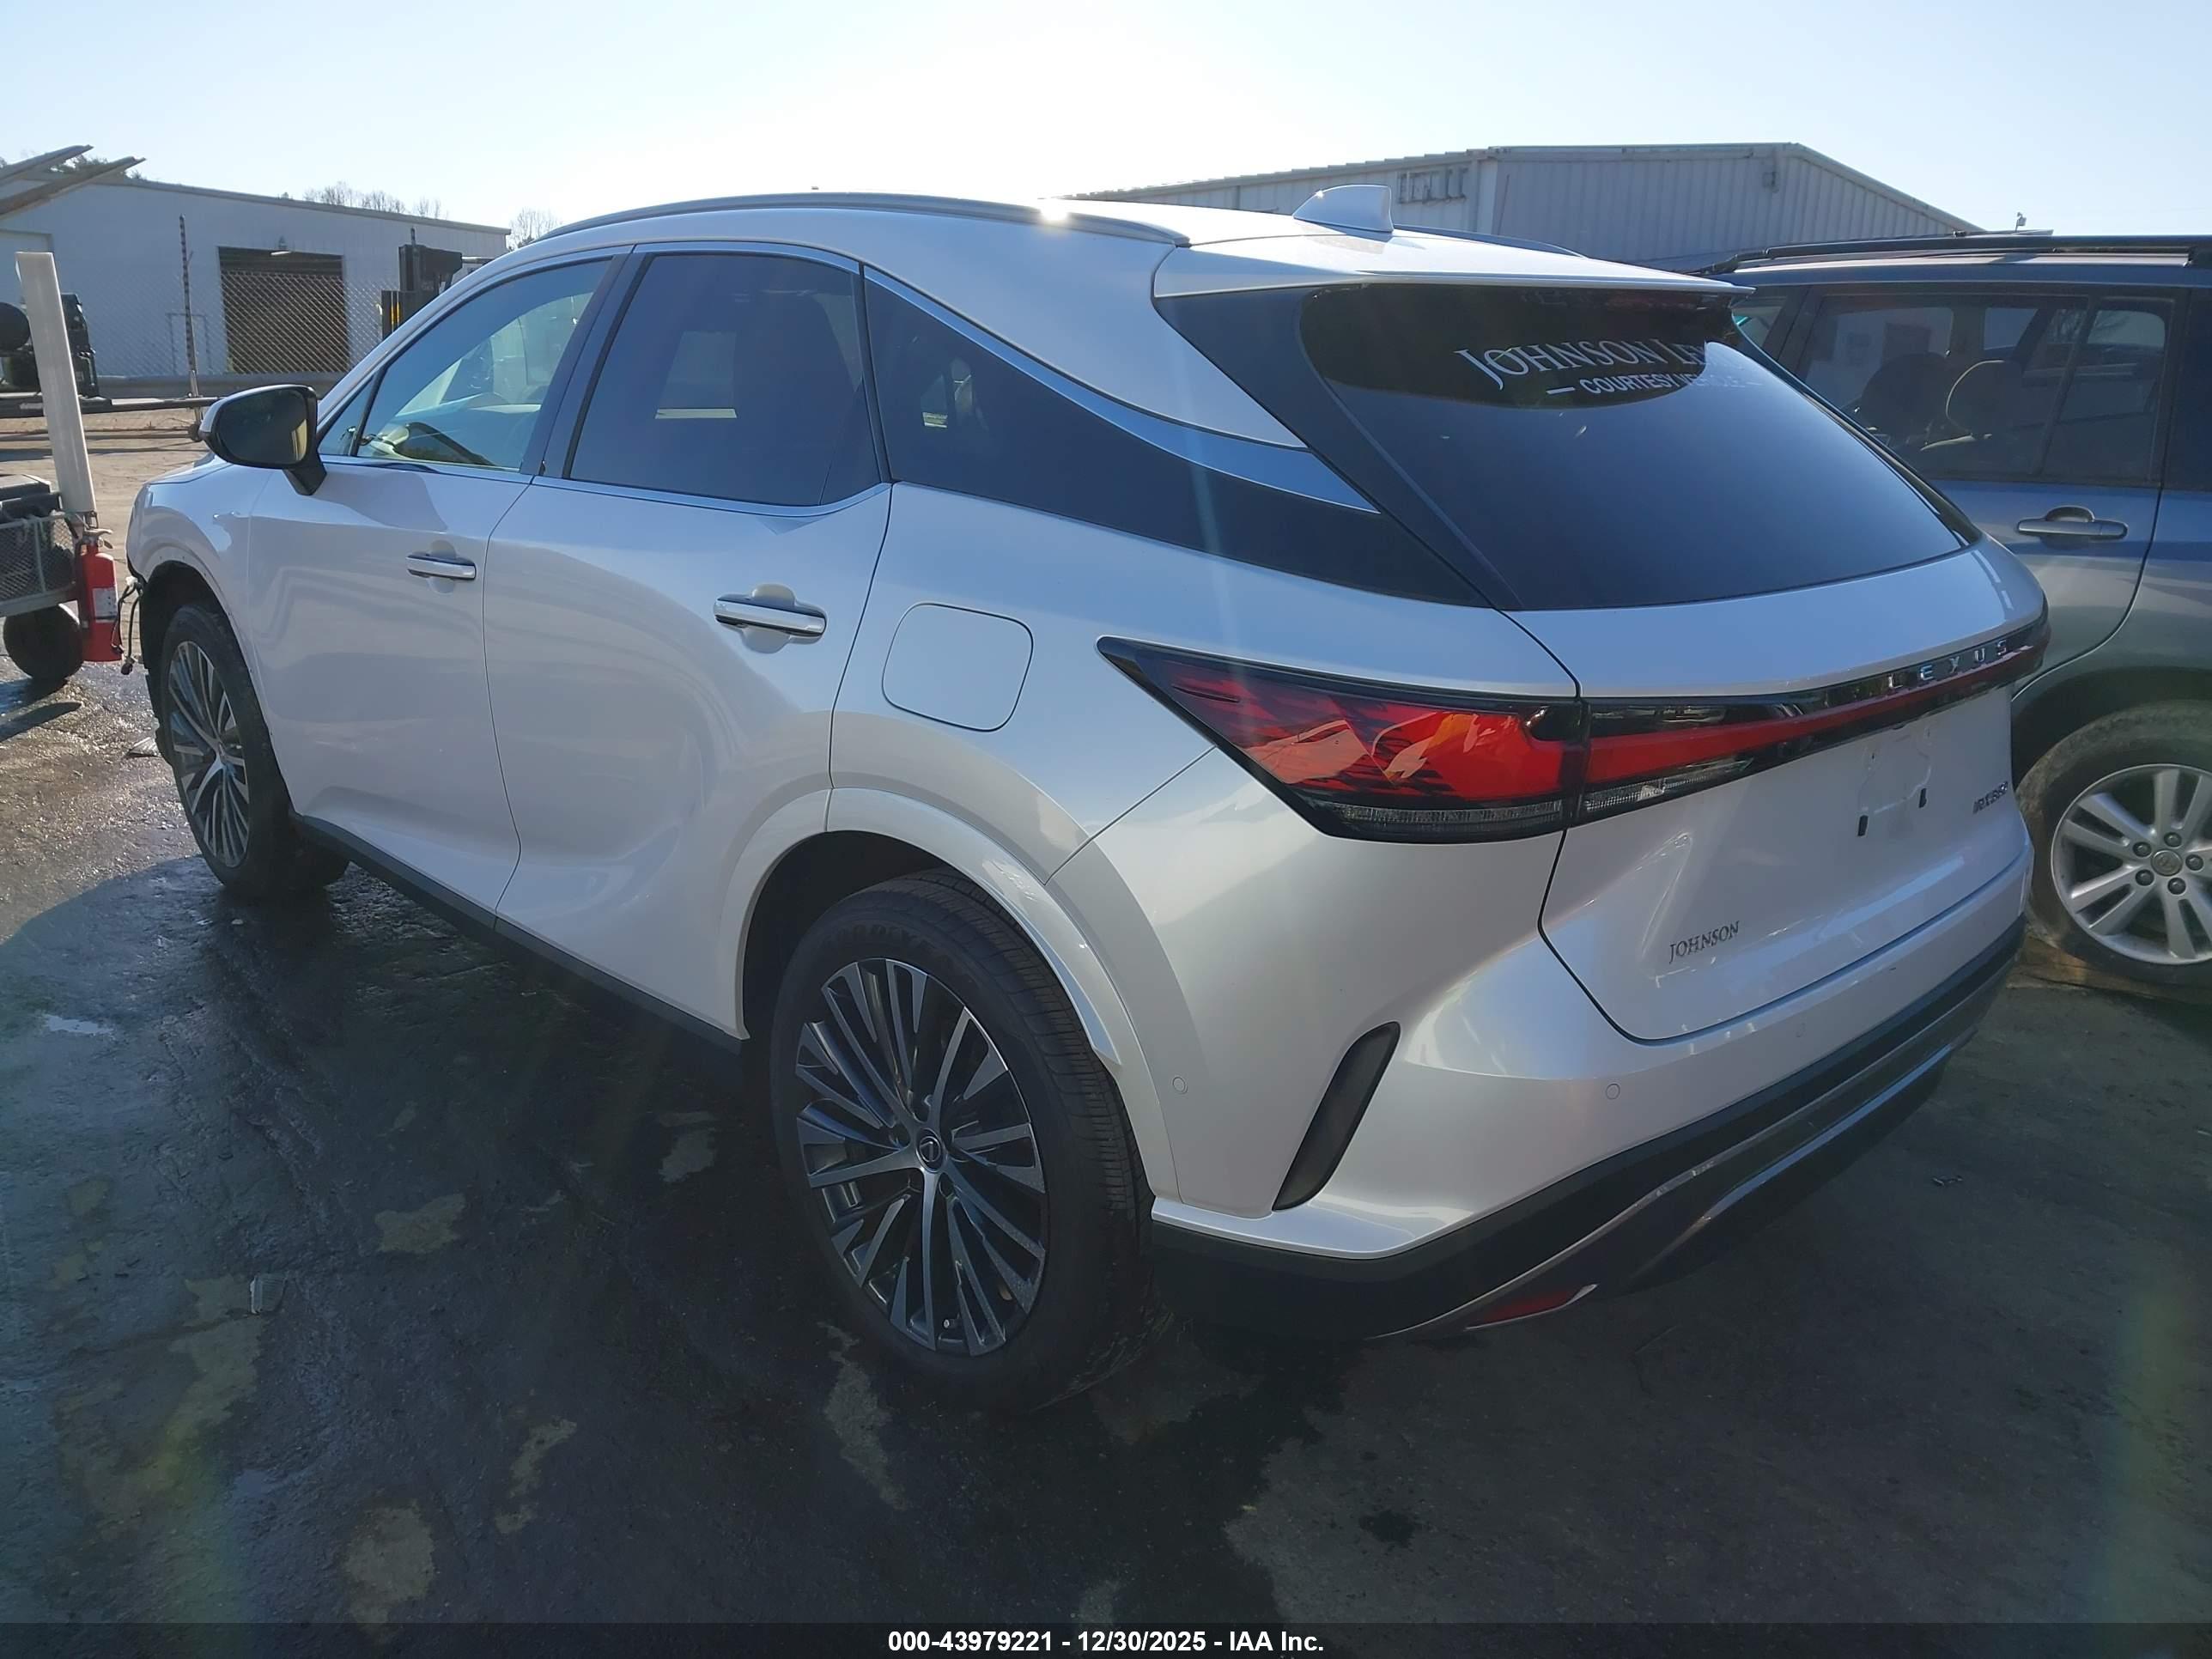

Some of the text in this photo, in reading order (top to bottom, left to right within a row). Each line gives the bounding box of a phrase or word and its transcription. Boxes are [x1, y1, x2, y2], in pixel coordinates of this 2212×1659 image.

[1454, 338, 1668, 391] JOHNSON
[1579, 372, 1680, 395] COURTESY
[1888, 639, 2008, 689] LEXUS
[1668, 921, 1740, 964] JOHNSON
